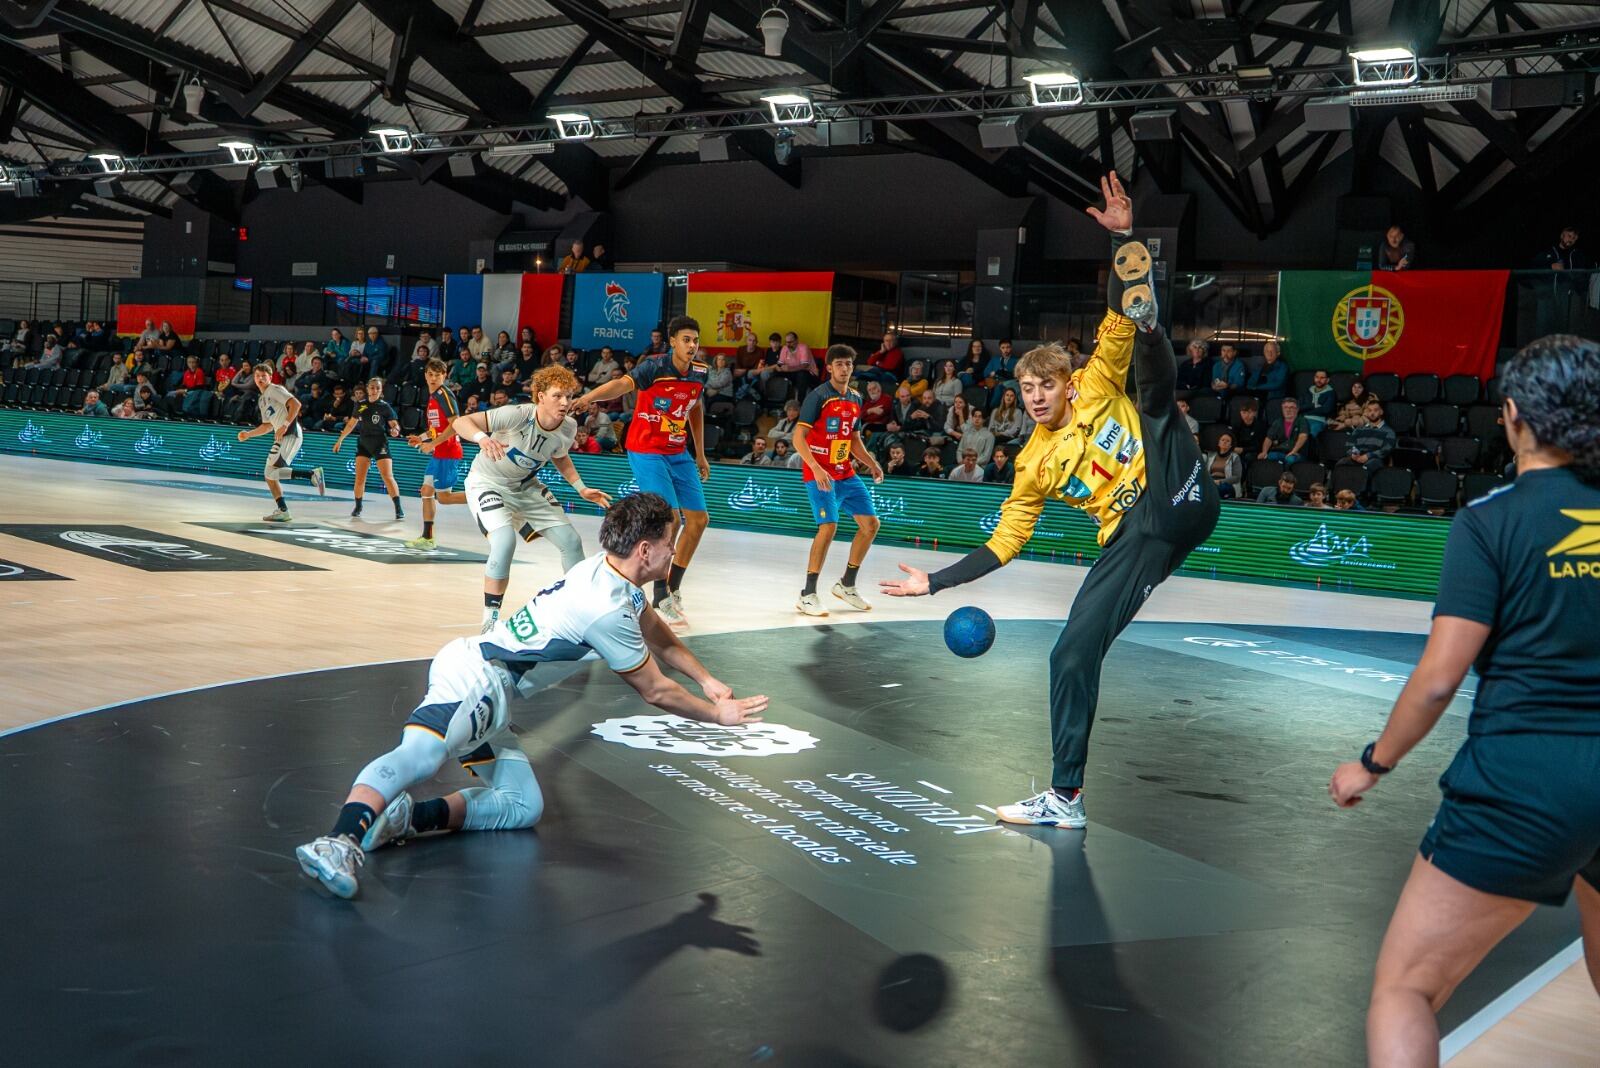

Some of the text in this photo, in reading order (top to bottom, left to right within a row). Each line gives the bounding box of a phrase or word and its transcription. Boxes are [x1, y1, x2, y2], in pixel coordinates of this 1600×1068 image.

[672, 404, 683, 418] 4
[841, 421, 850, 436] 5
[531, 434, 547, 453] 17
[1091, 460, 1114, 482] 1
[1549, 562, 1576, 578] LA
[648, 763, 851, 865] sur mesure et locales
[691, 760, 918, 866] Intelligence Artificielle
[783, 780, 910, 834] Formations
